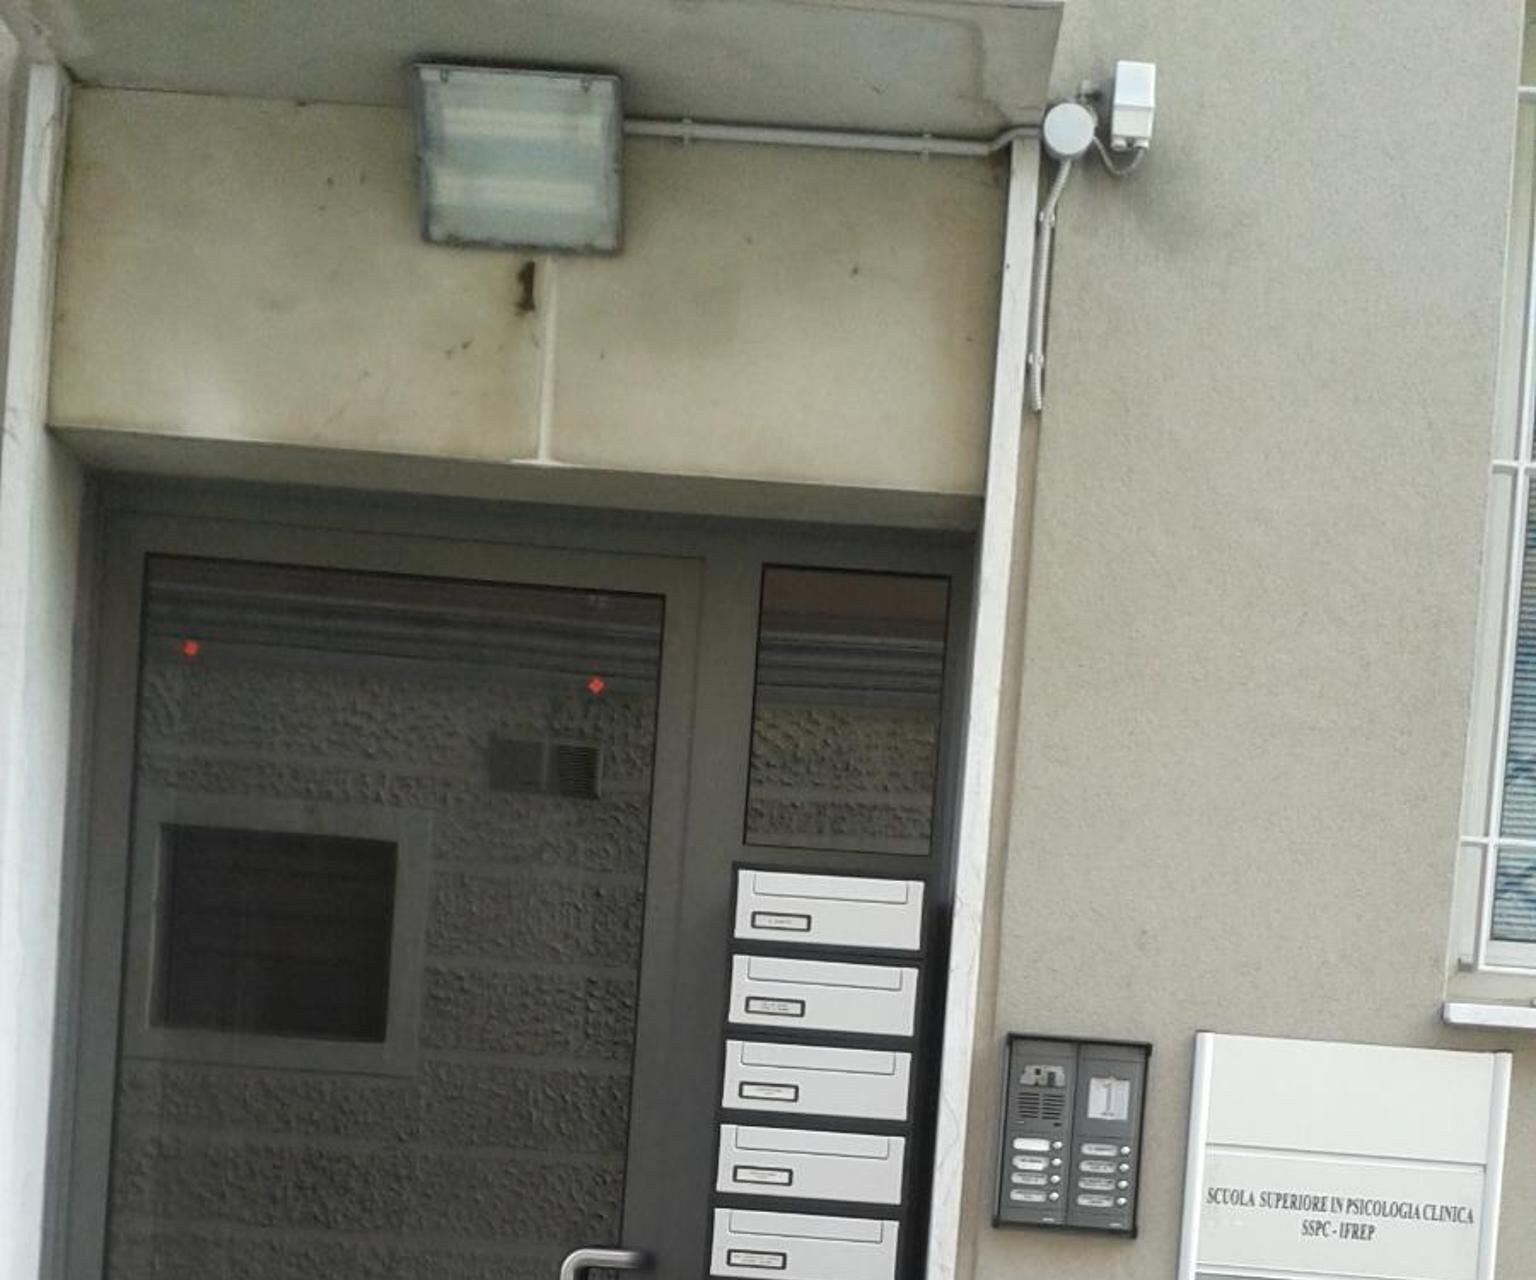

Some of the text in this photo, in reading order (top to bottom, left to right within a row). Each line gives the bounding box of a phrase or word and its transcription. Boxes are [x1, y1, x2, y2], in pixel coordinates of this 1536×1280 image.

[1206, 1187, 1474, 1224] SCUOLA SUPERIORE IN PSICOLOGIA CLINICA
[1302, 1219, 1332, 1237] SSPC
[1339, 1221, 1376, 1241] IFREP
